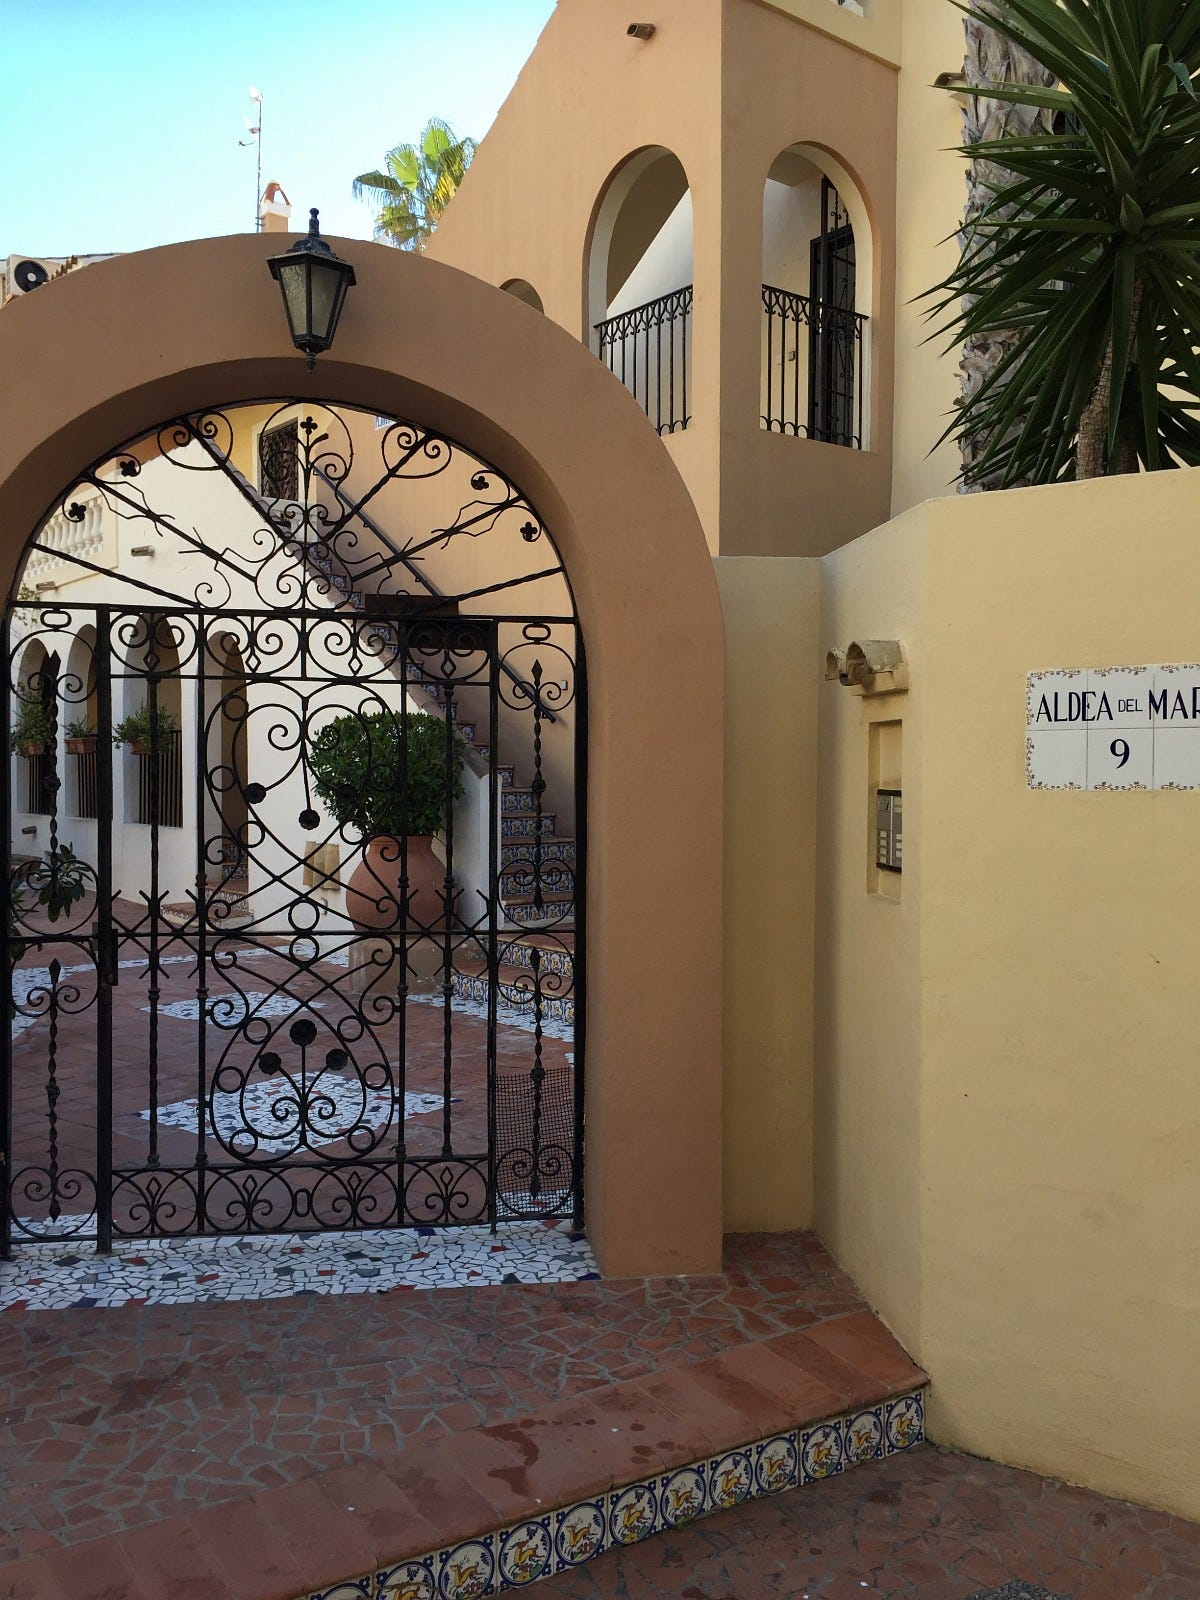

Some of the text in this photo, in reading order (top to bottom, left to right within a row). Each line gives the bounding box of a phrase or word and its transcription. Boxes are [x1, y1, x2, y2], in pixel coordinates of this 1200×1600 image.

[1036, 691, 1113, 722] ALDEA
[1118, 699, 1143, 712] DEL
[1110, 738, 1130, 769] 9
